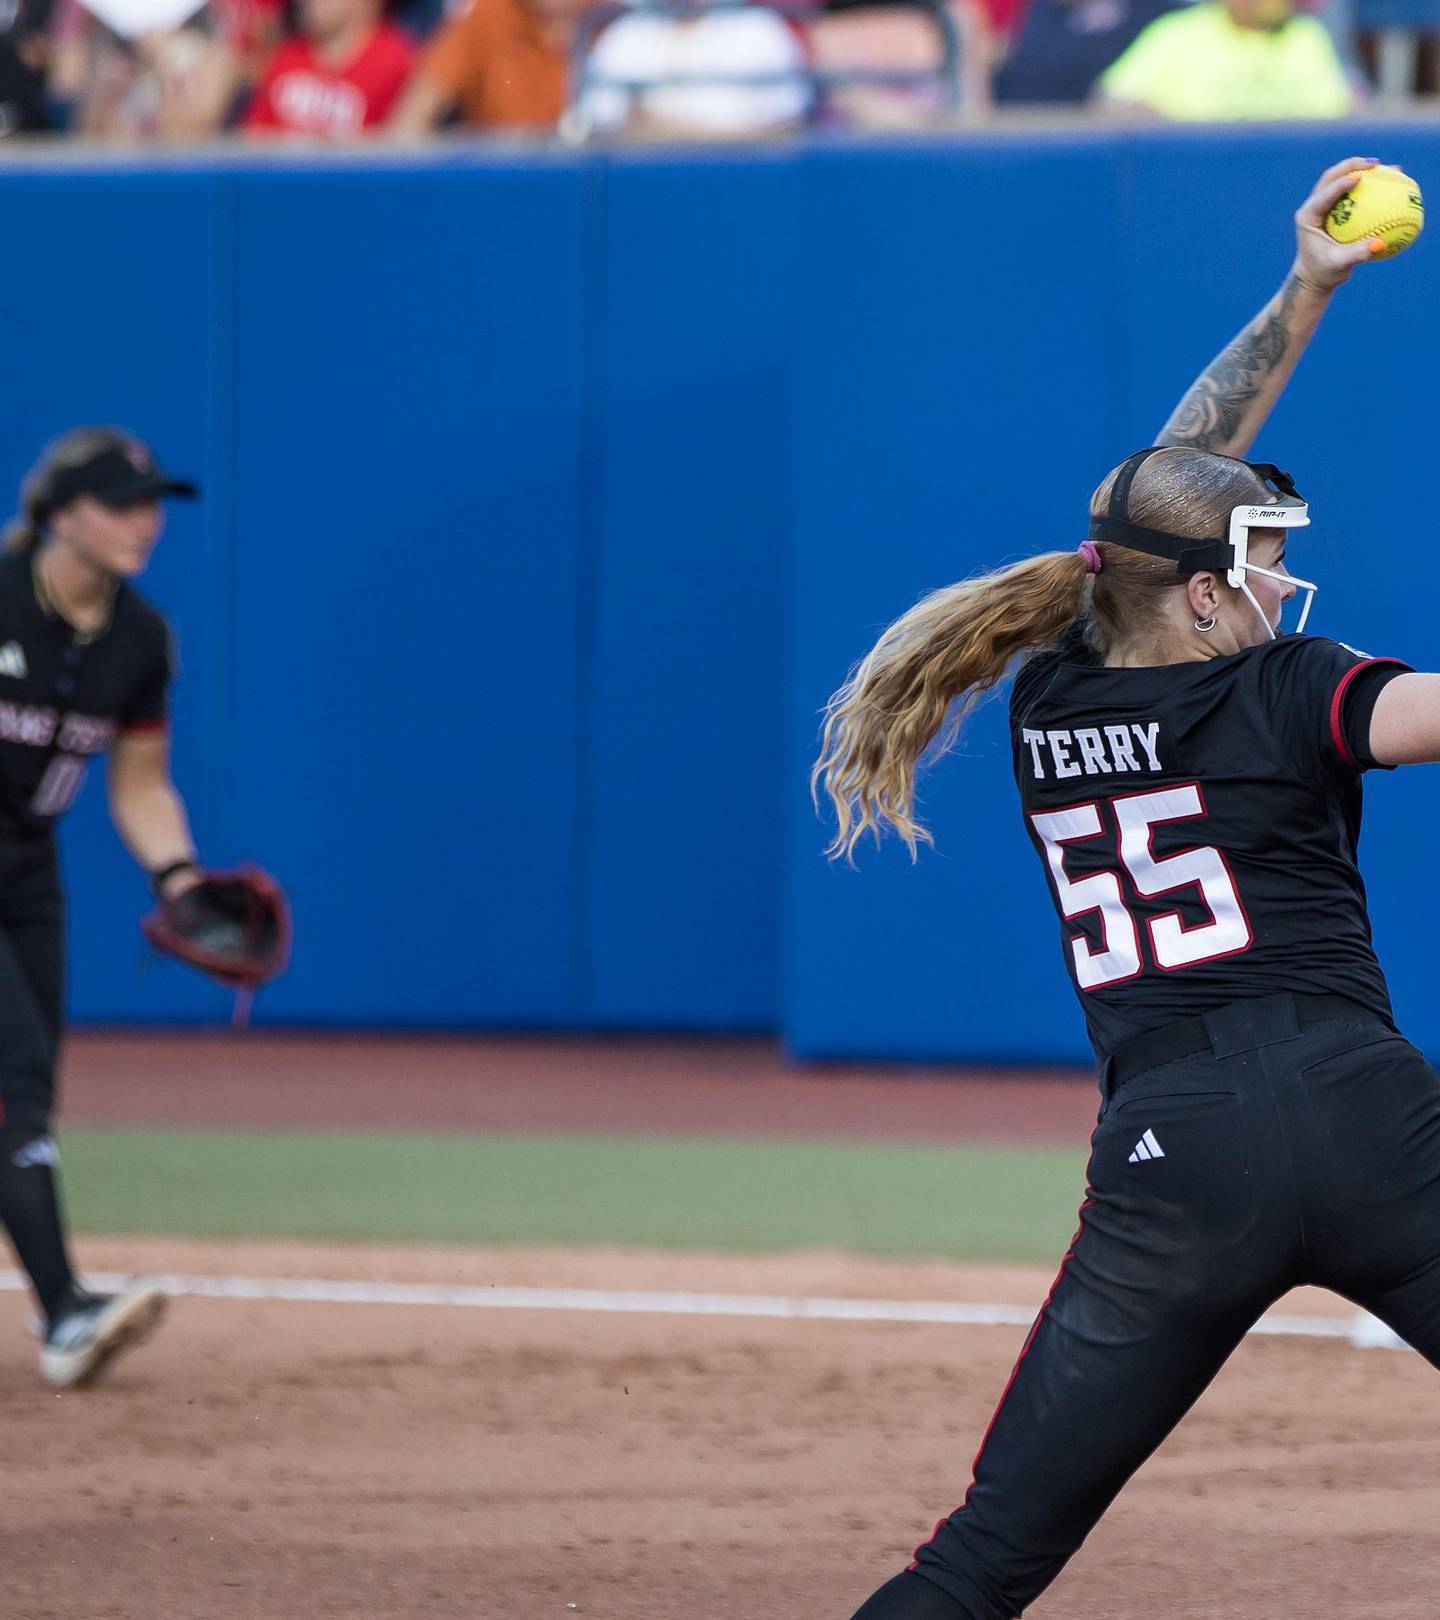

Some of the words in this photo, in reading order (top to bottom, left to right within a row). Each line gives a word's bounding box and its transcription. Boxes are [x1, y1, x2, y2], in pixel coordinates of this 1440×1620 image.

[1259, 510, 1287, 518] RIP-IT
[1021, 722, 1163, 780] TERRY
[1028, 780, 1255, 993] 55
